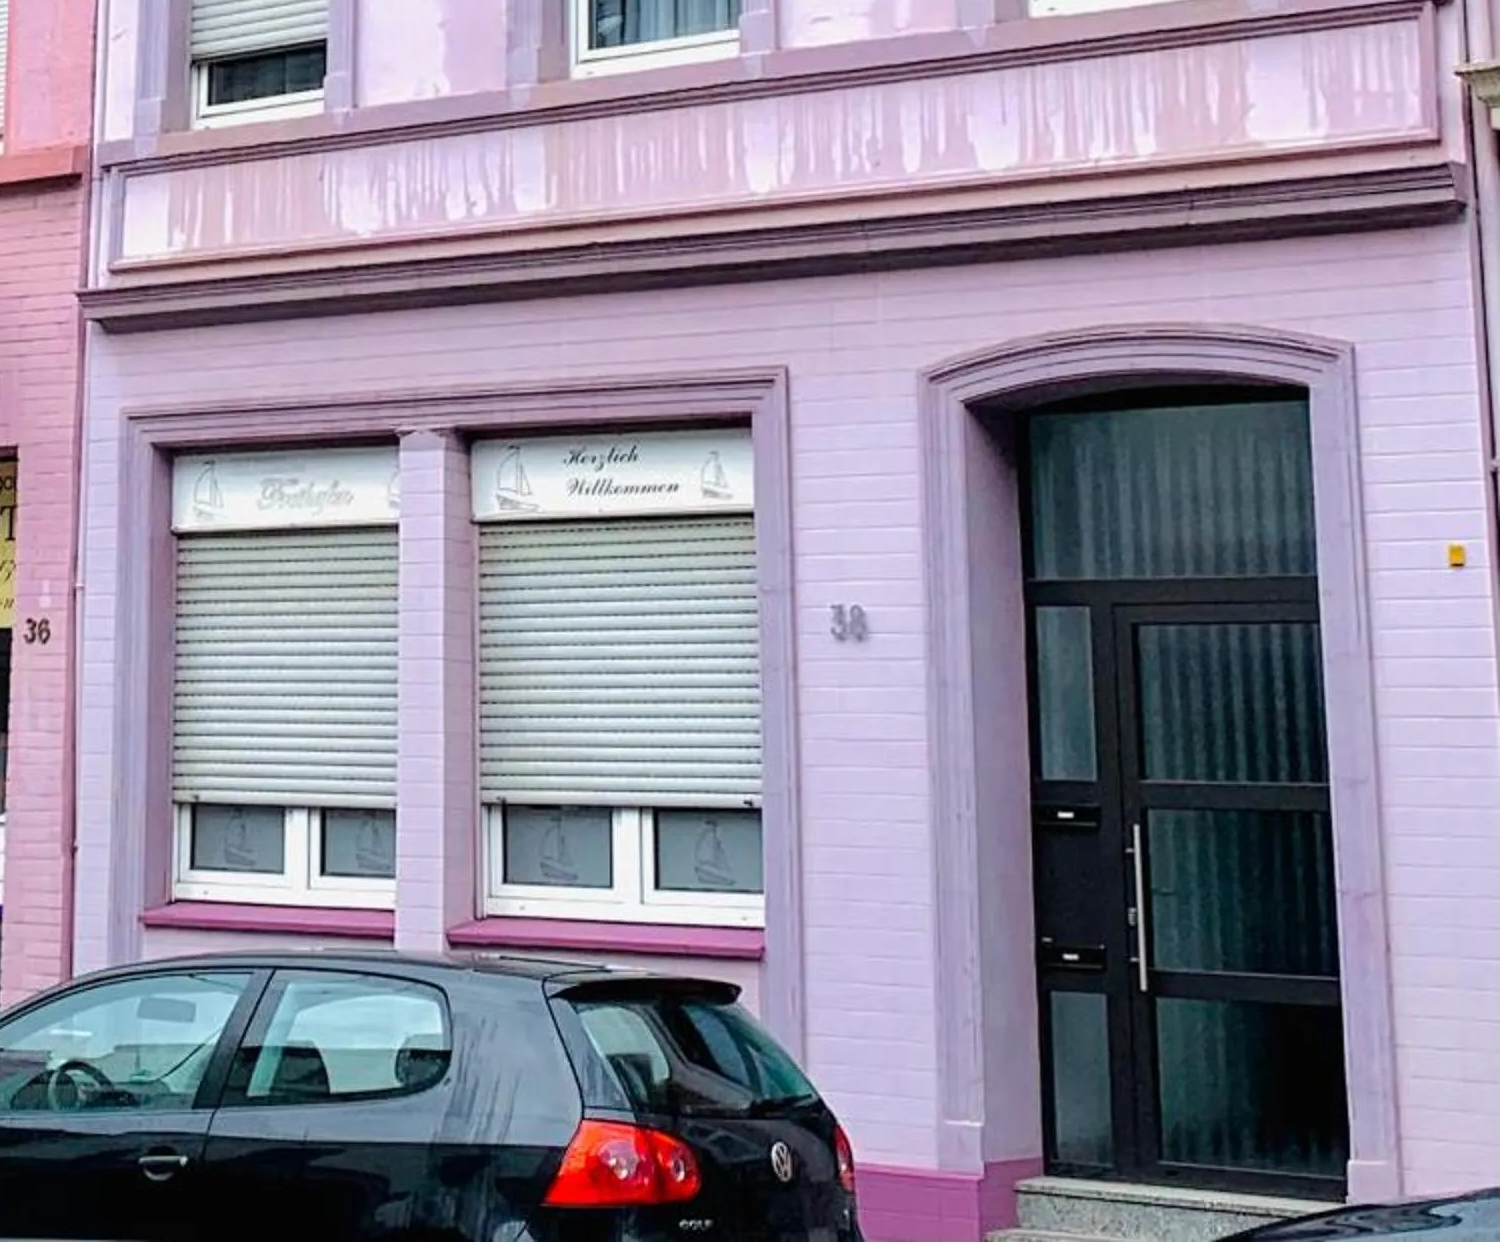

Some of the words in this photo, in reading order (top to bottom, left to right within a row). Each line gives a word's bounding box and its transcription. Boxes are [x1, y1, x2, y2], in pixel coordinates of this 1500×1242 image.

[563, 443, 641, 472] Herzlich
[566, 477, 680, 496] Willkommen
[23, 617, 51, 645] 36
[830, 603, 868, 643] 38
